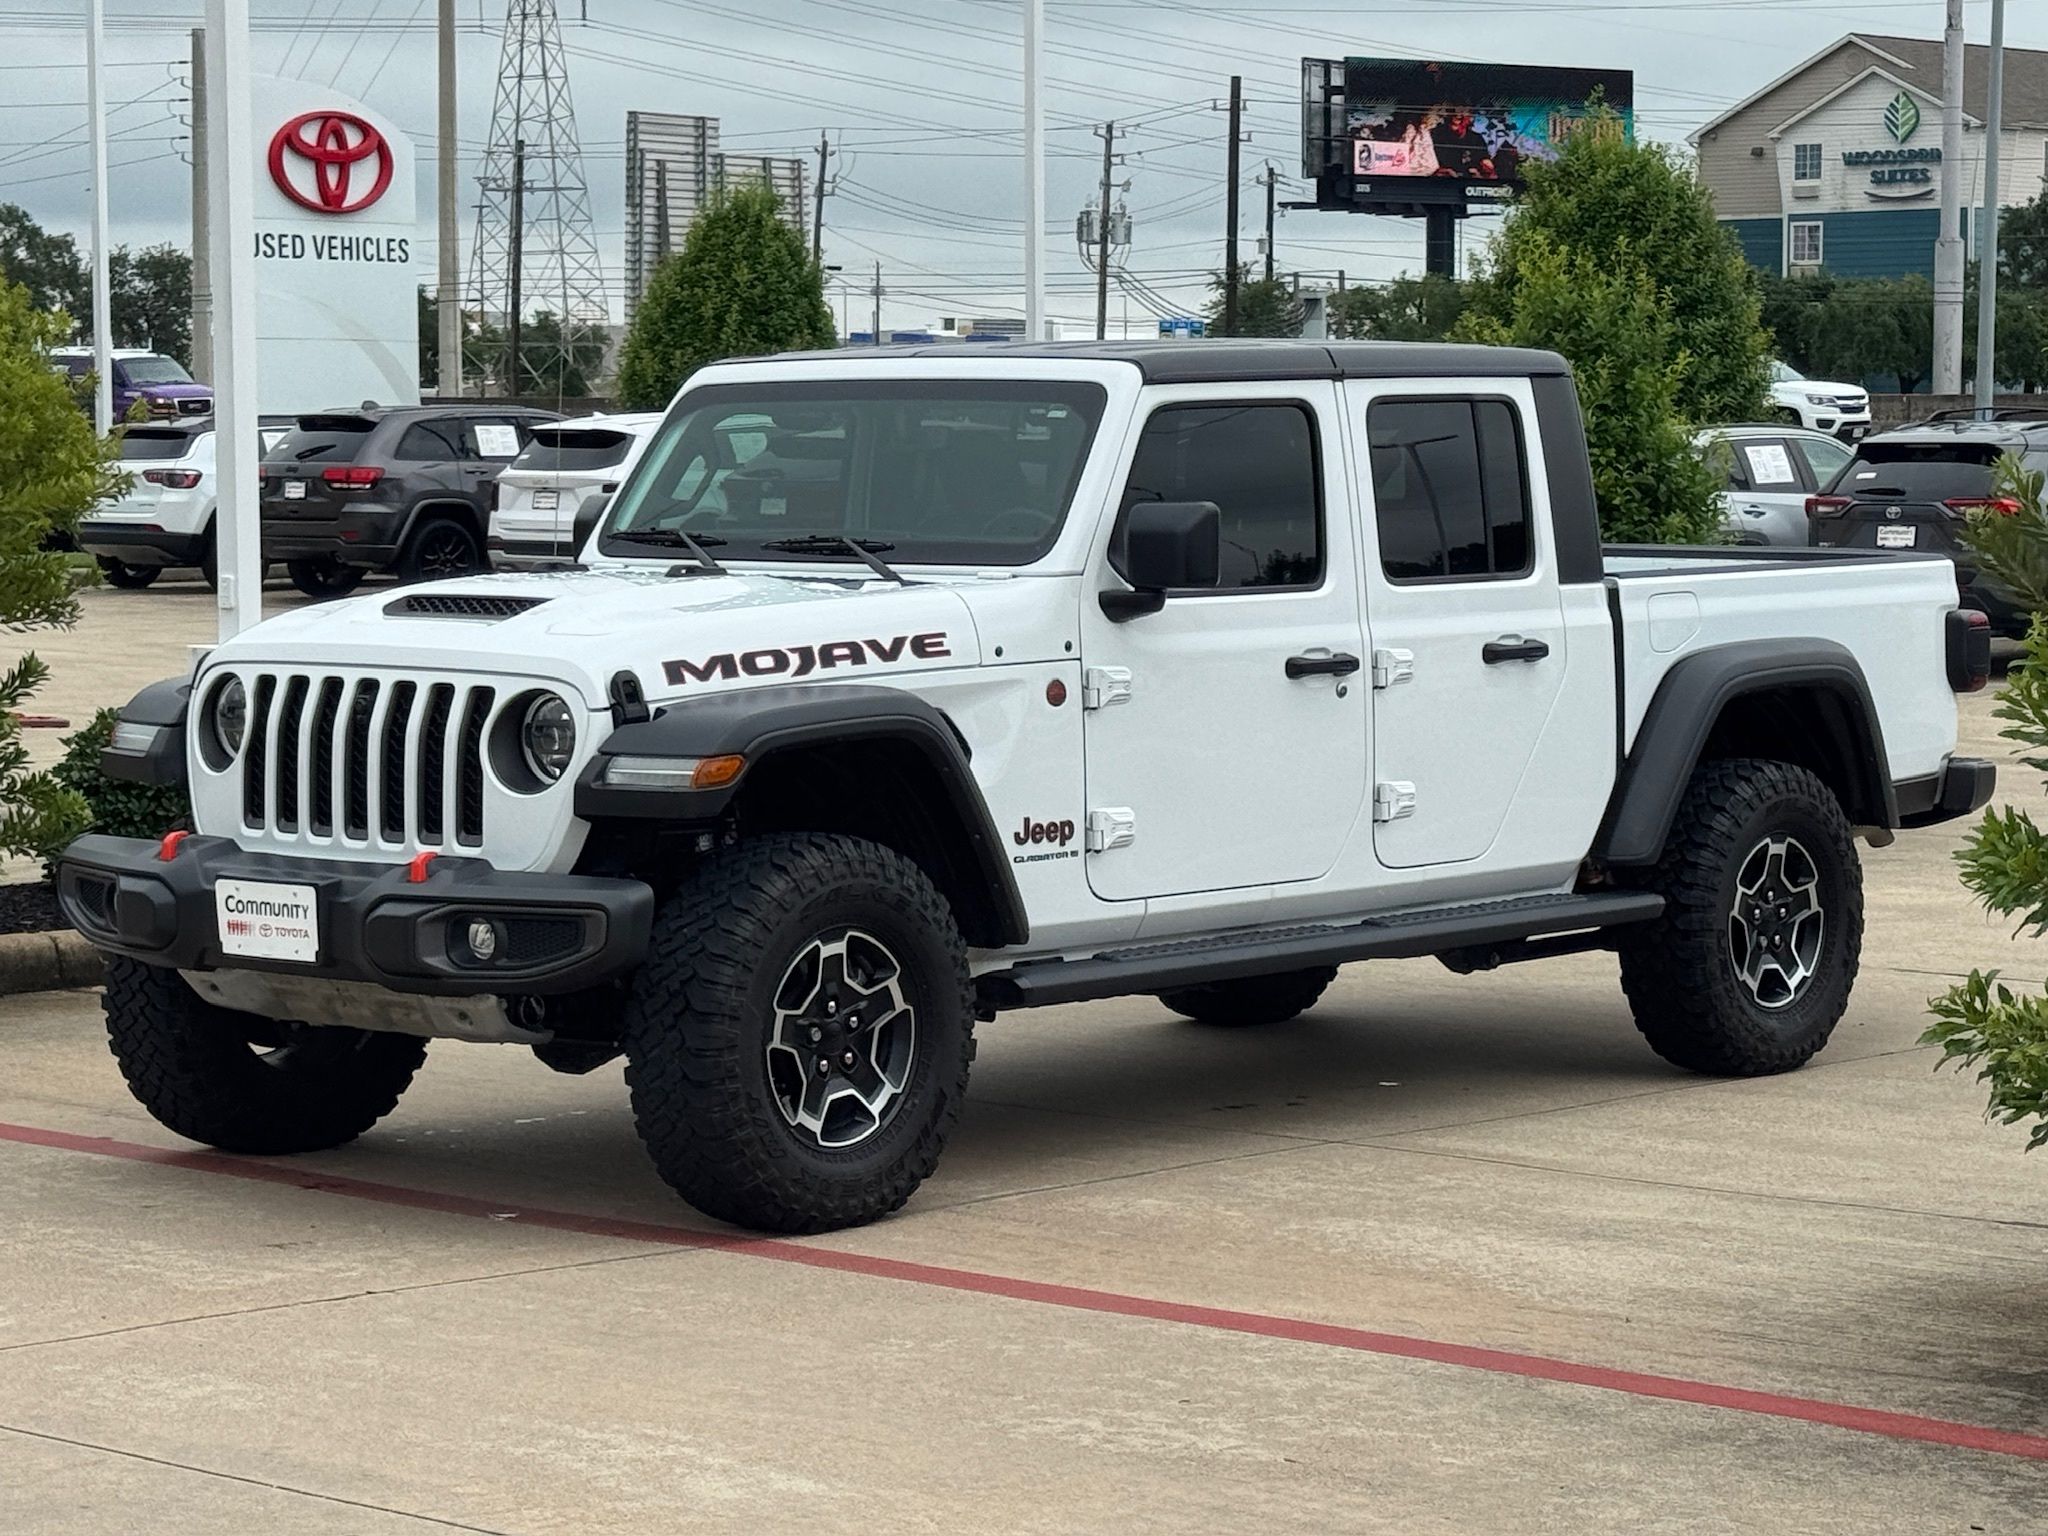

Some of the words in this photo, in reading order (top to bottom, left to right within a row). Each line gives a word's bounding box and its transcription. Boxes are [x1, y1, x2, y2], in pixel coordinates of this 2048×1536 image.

[1870, 168, 1931, 184] SUITES
[312, 235, 409, 263] VEHICLES
[662, 632, 952, 686] MOJAVE
[1014, 816, 1075, 847] Jeep
[1013, 851, 1069, 864] GLADIATOR
[225, 895, 309, 920] Community
[275, 927, 310, 939] TOYOTA
